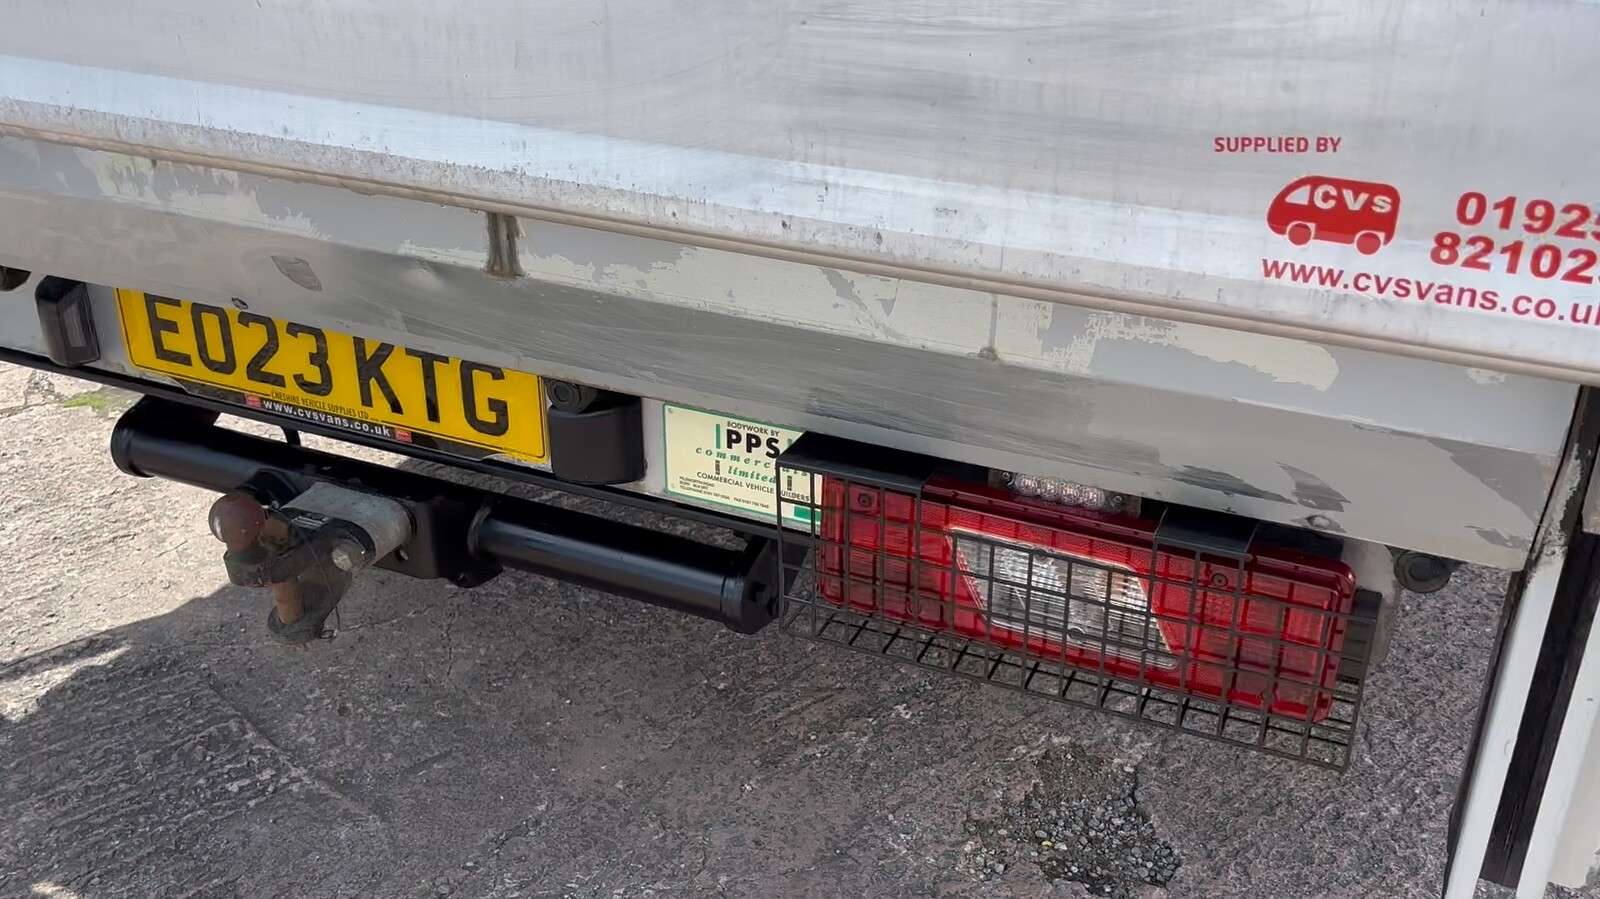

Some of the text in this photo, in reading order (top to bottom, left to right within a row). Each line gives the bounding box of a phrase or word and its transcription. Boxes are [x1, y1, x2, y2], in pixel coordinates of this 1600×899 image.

[1214, 137, 1341, 153] SUPPLIED BY
[1456, 191, 1600, 242] 0192
[1430, 231, 1600, 285] 82102
[352, 336, 510, 437] KTG
[263, 400, 391, 438] www.cvsvans.co.uk
[727, 421, 781, 438] BODYWORK BY
[726, 429, 781, 459] PPS
[696, 471, 744, 488] COMMERCIAL
[745, 482, 775, 495] VEHICLE
[781, 490, 810, 502] UILDERS
